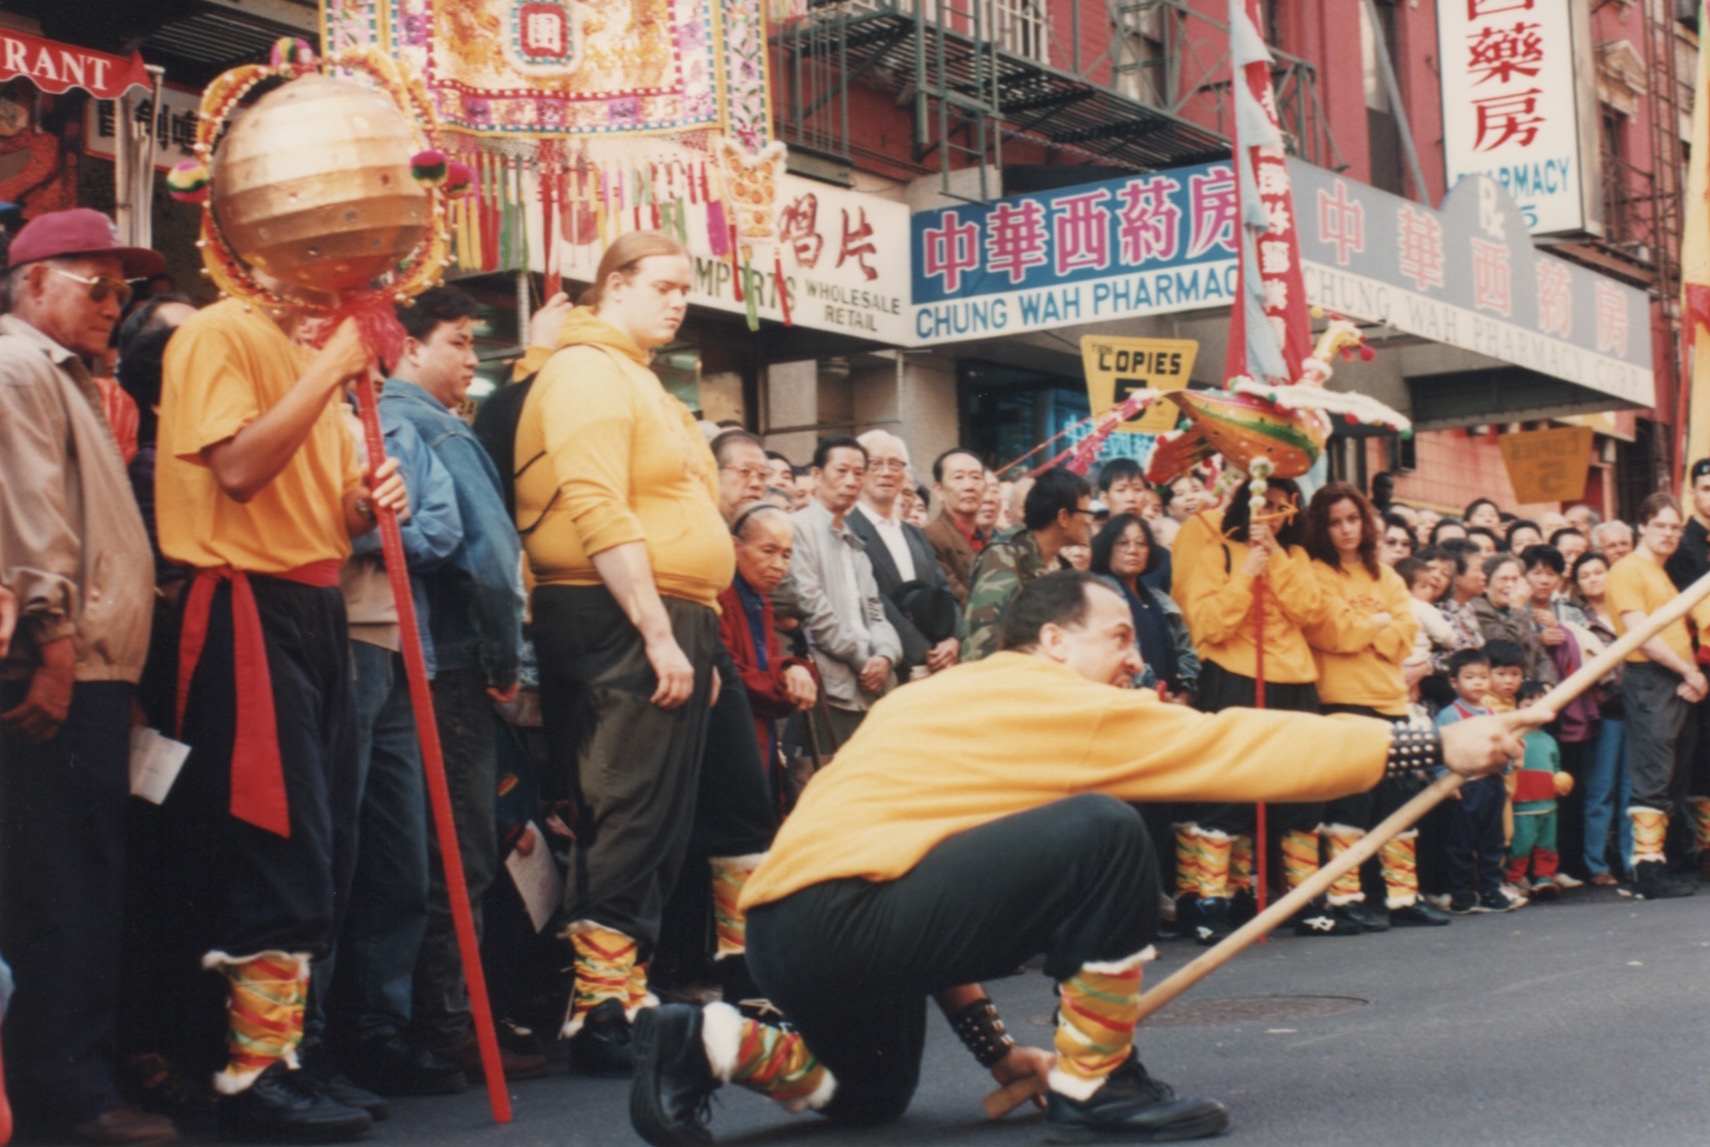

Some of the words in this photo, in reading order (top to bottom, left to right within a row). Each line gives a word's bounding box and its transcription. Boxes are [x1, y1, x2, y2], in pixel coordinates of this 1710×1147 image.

[0, 36, 112, 91] RANT
[805, 279, 901, 315] WHOLESALE
[824, 304, 879, 332] RETAIL
[916, 298, 1008, 339] CHUNG
[1019, 287, 1081, 325] WAH
[1093, 264, 1240, 315] PHARMAC
[1405, 295, 1458, 342] WAH
[1475, 317, 1586, 379] PHARMACY
[1098, 349, 1183, 375] COPIES
